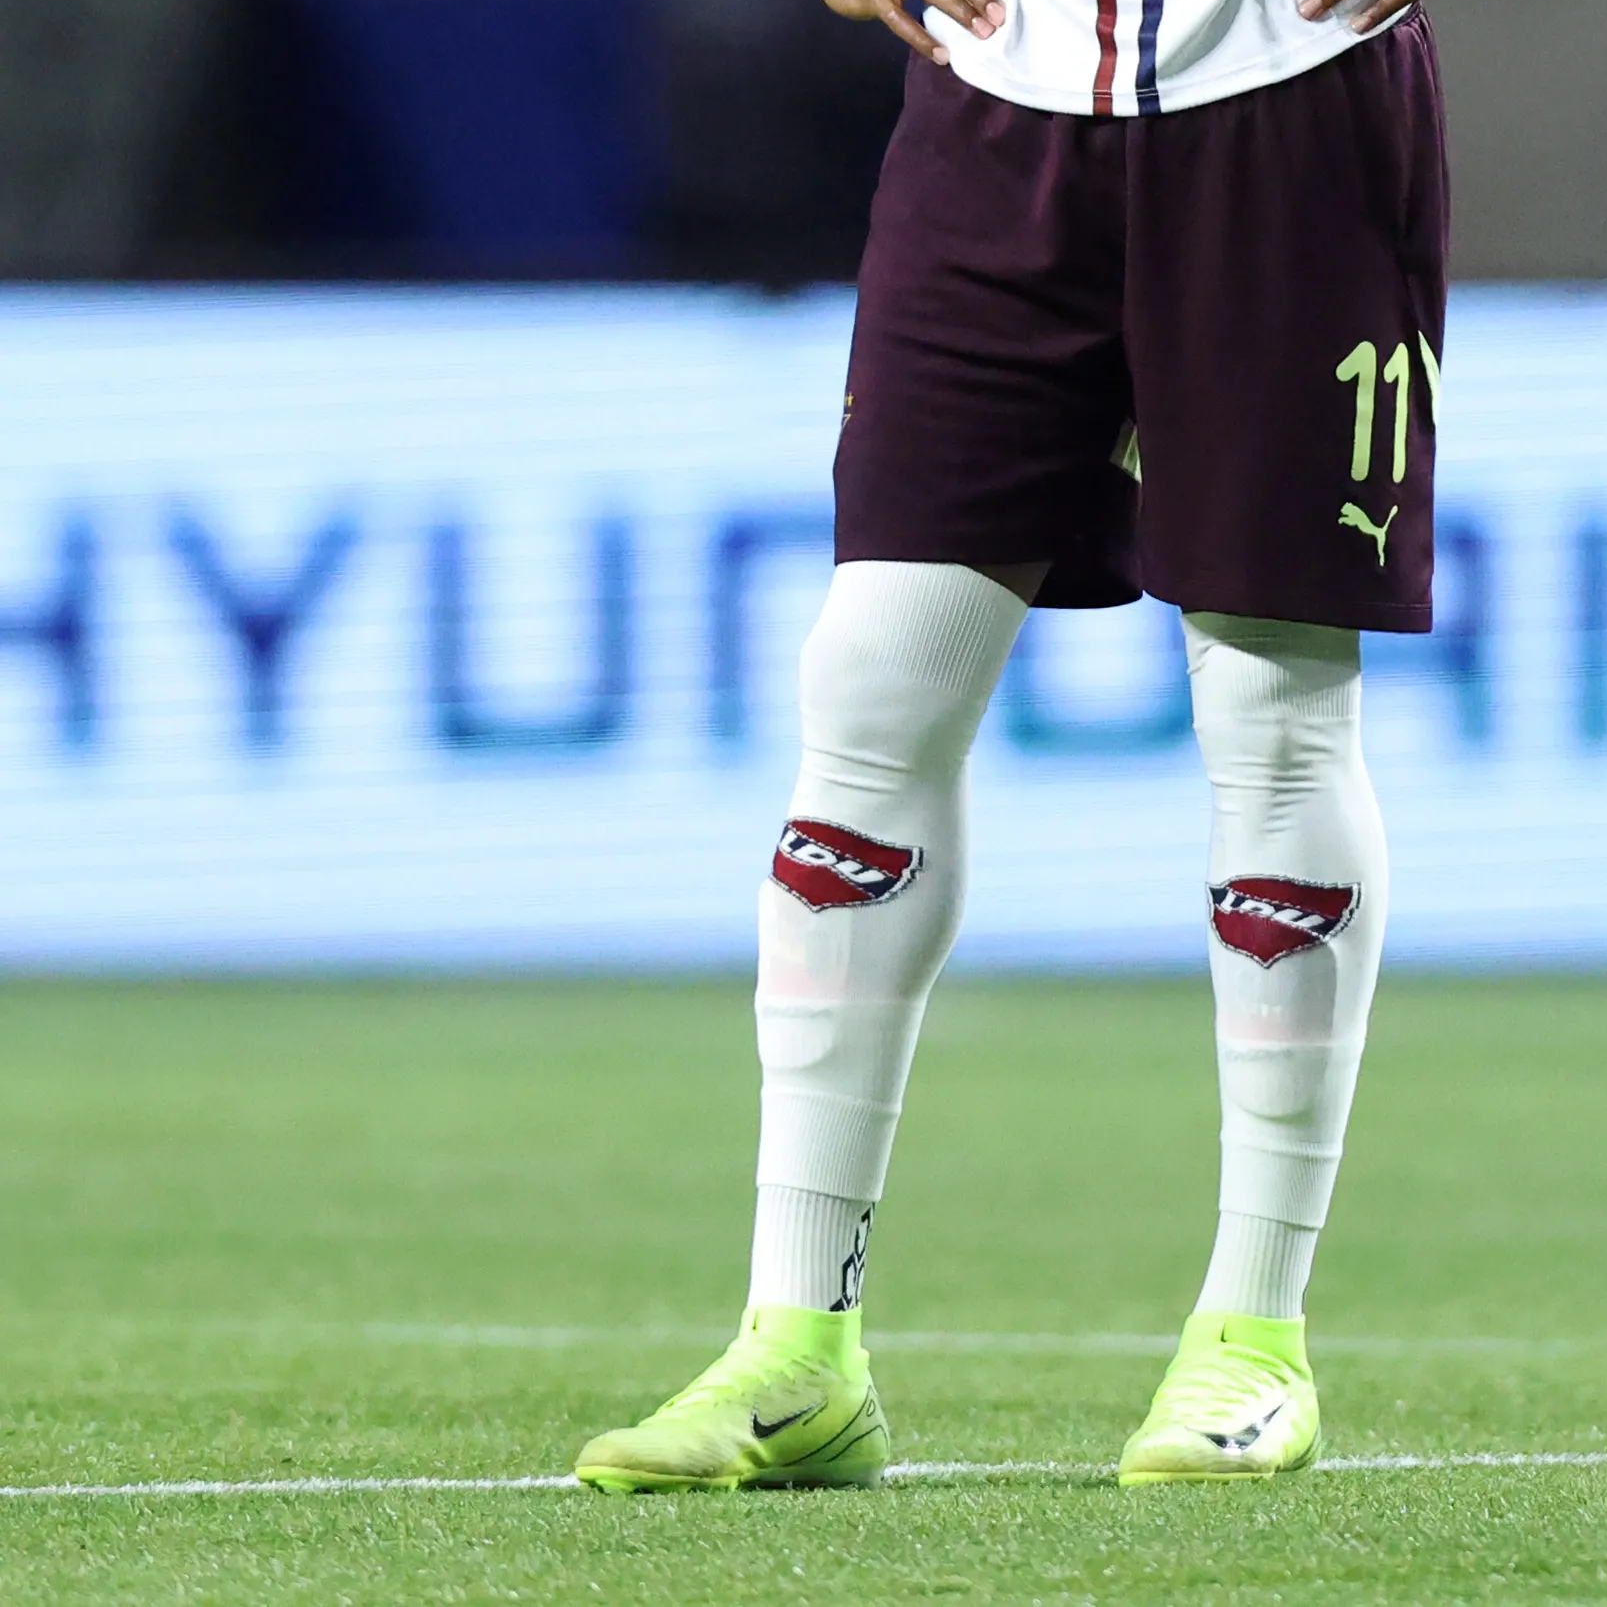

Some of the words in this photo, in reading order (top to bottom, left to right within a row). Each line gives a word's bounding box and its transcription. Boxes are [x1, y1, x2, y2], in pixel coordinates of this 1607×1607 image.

[1335, 340, 1410, 484] 11
[780, 830, 886, 884] LDU
[1220, 889, 1326, 930] LDU
